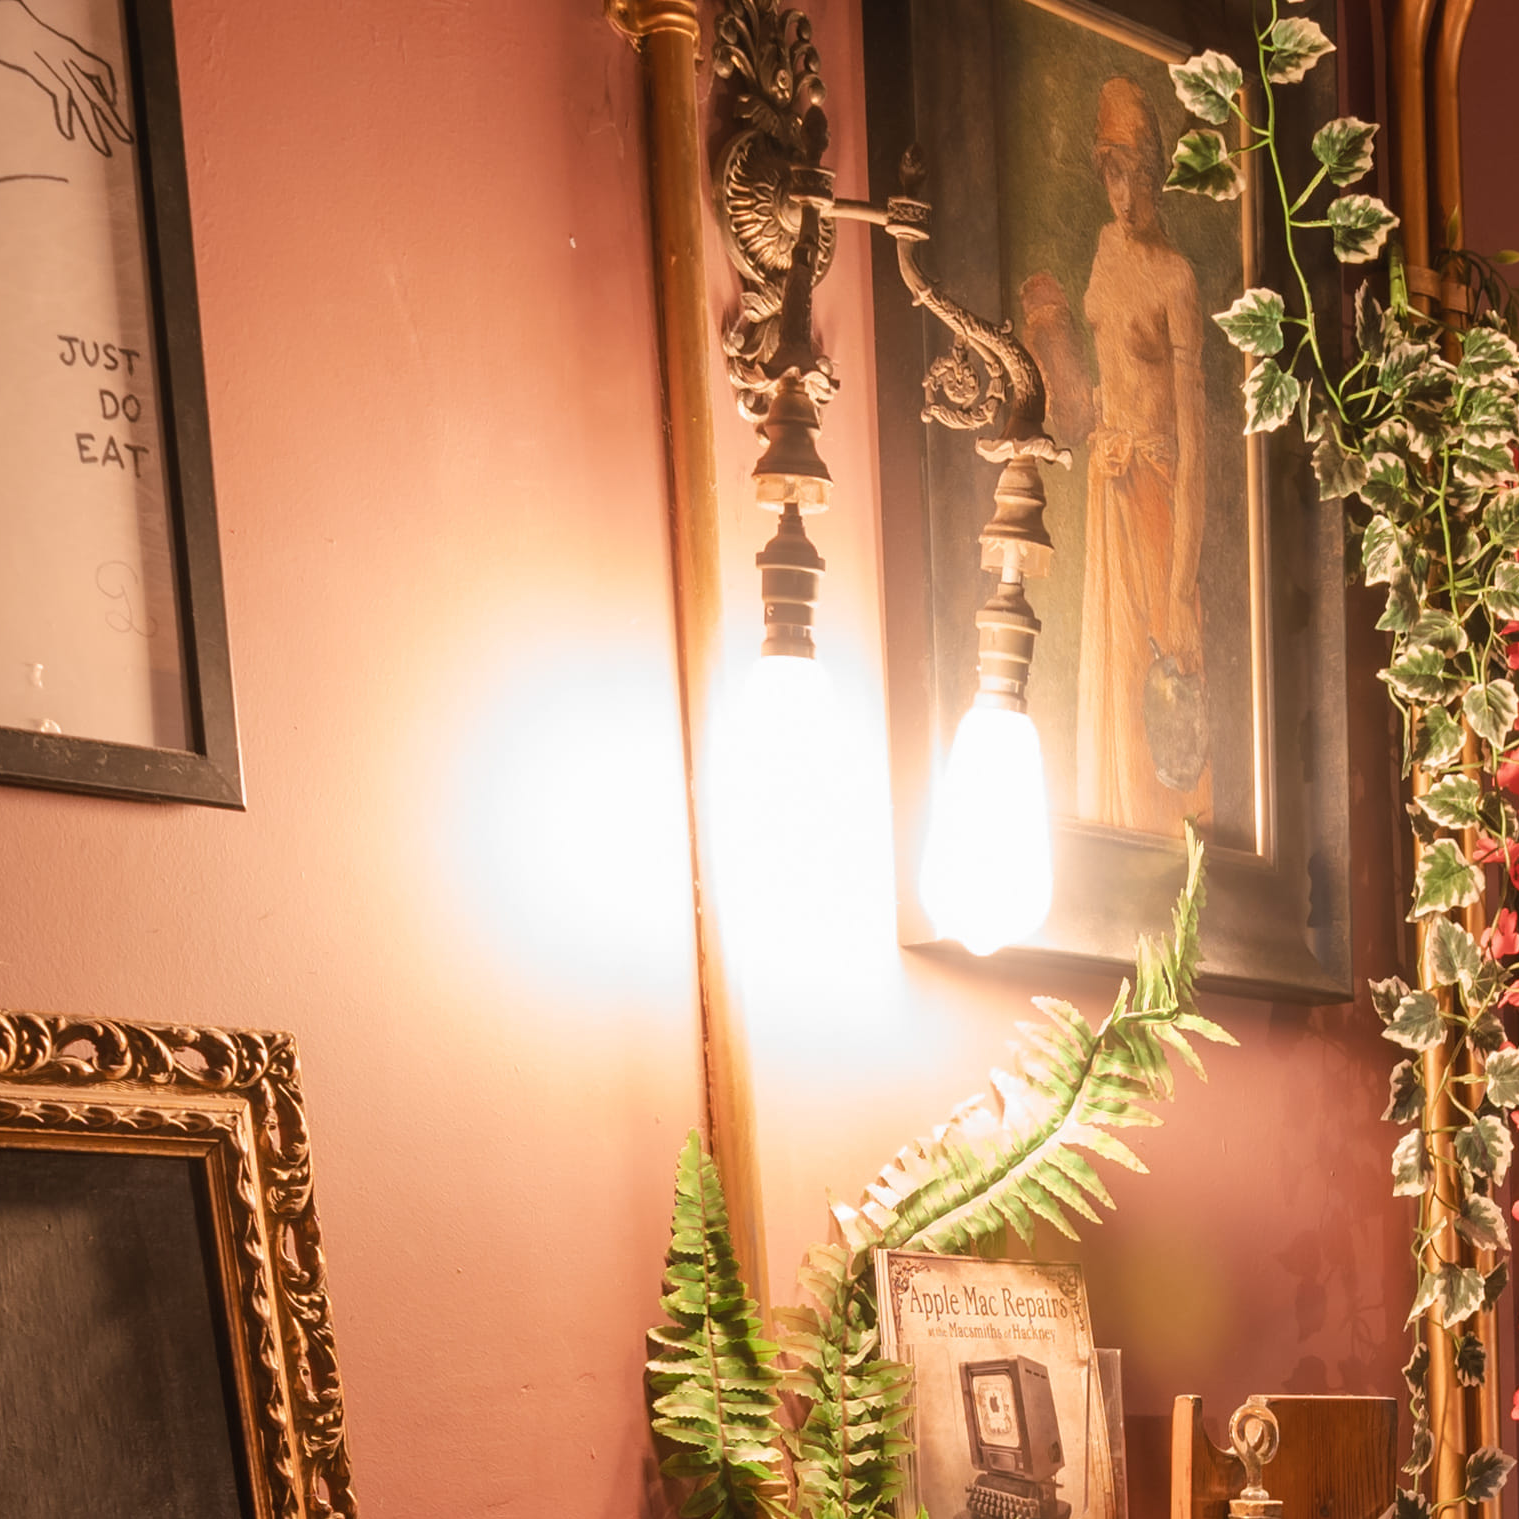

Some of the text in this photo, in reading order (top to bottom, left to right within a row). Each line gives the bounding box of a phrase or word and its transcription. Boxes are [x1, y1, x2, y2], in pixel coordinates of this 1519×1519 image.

[57, 334, 140, 376] JUST
[98, 388, 142, 423] DO
[75, 432, 149, 479] EAT
[910, 1284, 1069, 1324] Apple Mac Repairs
[948, 1322, 1003, 1340] Macsmiths
[1012, 1323, 1057, 1344] Hackney
